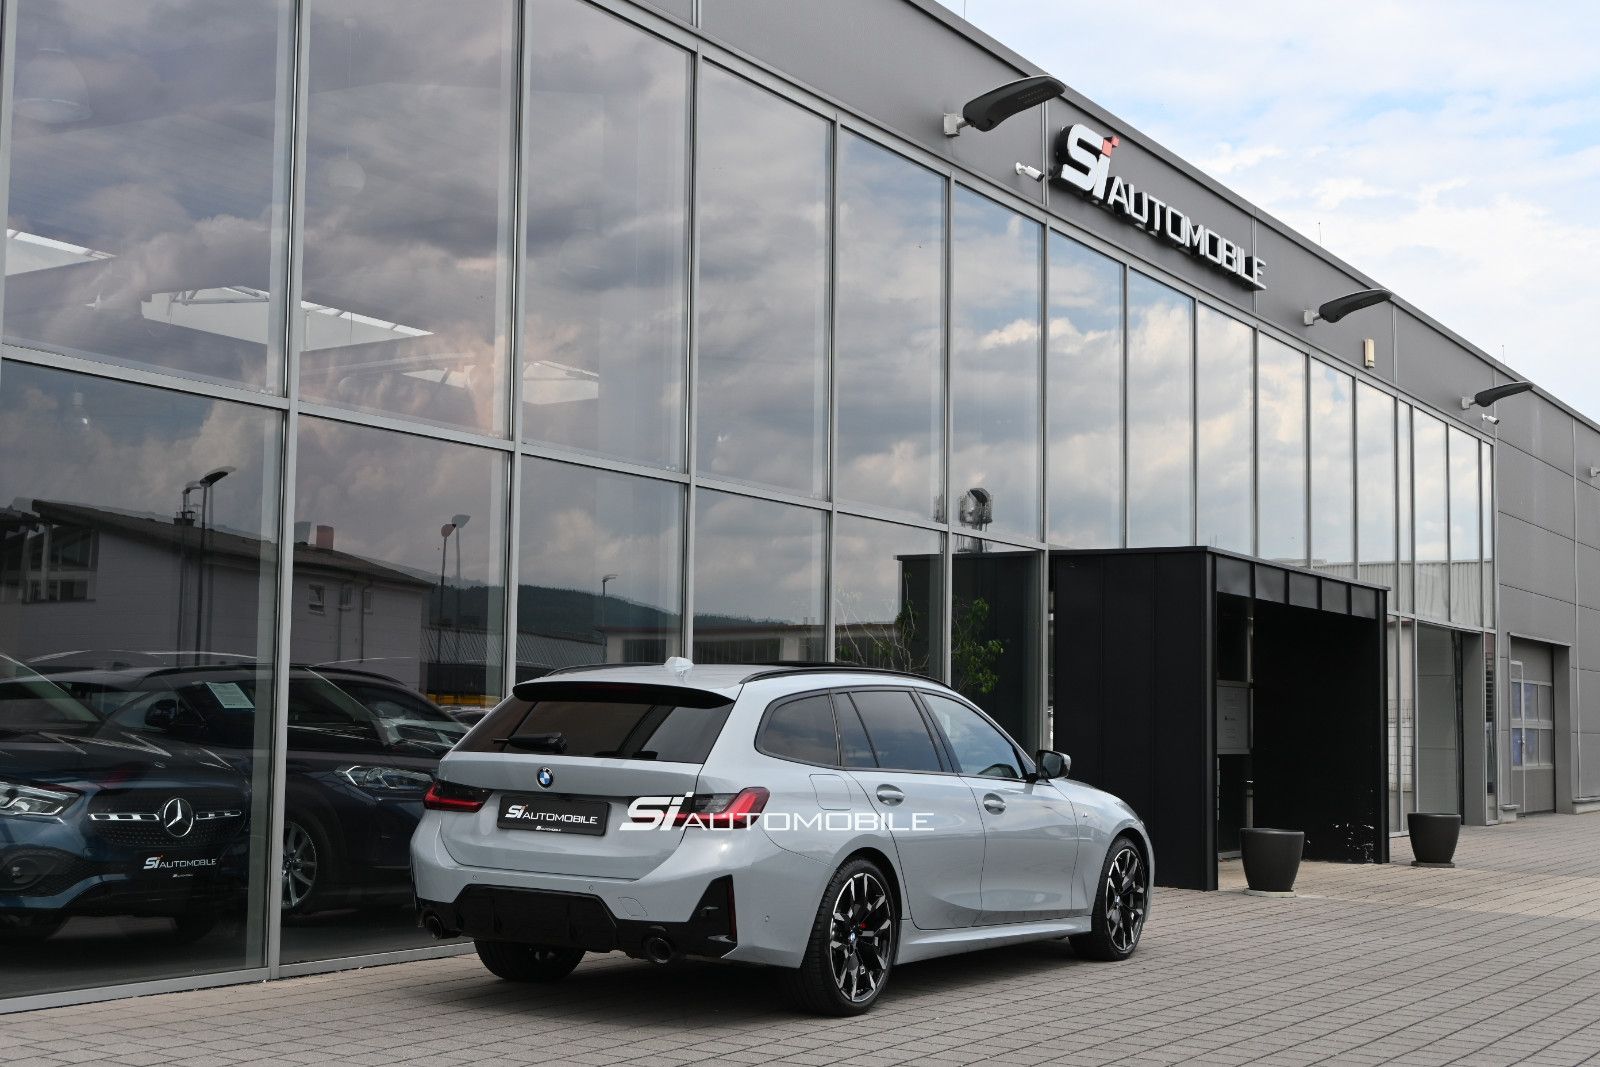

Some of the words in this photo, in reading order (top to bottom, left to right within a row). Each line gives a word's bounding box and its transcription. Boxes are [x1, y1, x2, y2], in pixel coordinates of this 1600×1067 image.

[1107, 175, 1266, 290] AUTOMOBILE
[522, 812, 598, 824] AUTOMOBILE
[159, 858, 217, 869] AUTOMOBILE
